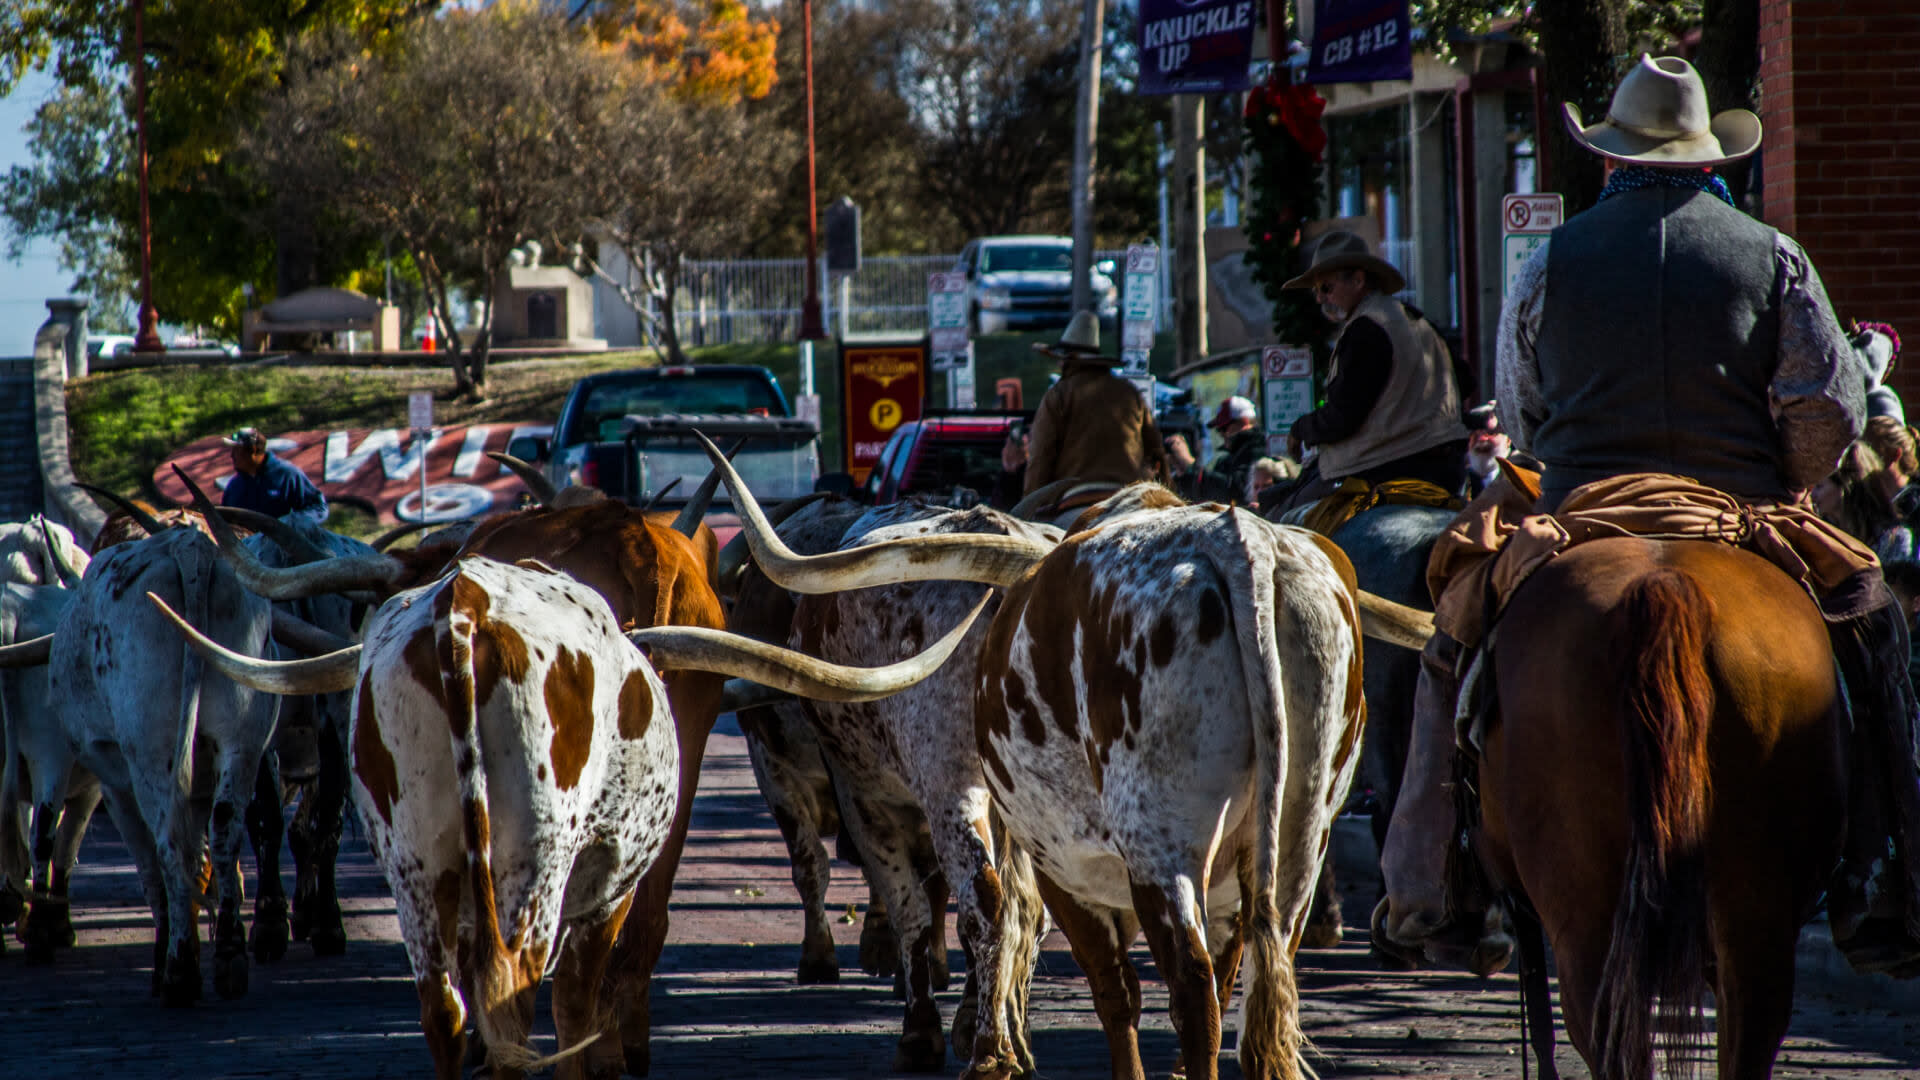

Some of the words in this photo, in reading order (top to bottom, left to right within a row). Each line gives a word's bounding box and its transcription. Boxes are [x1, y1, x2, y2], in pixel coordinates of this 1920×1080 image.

[1143, 2, 1251, 49] KNUCKLE
[1323, 36, 1354, 66] CB
[1357, 19, 1399, 55] #12
[1158, 43, 1190, 72] UP
[1527, 238, 1539, 249] 30
[877, 403, 893, 425] P
